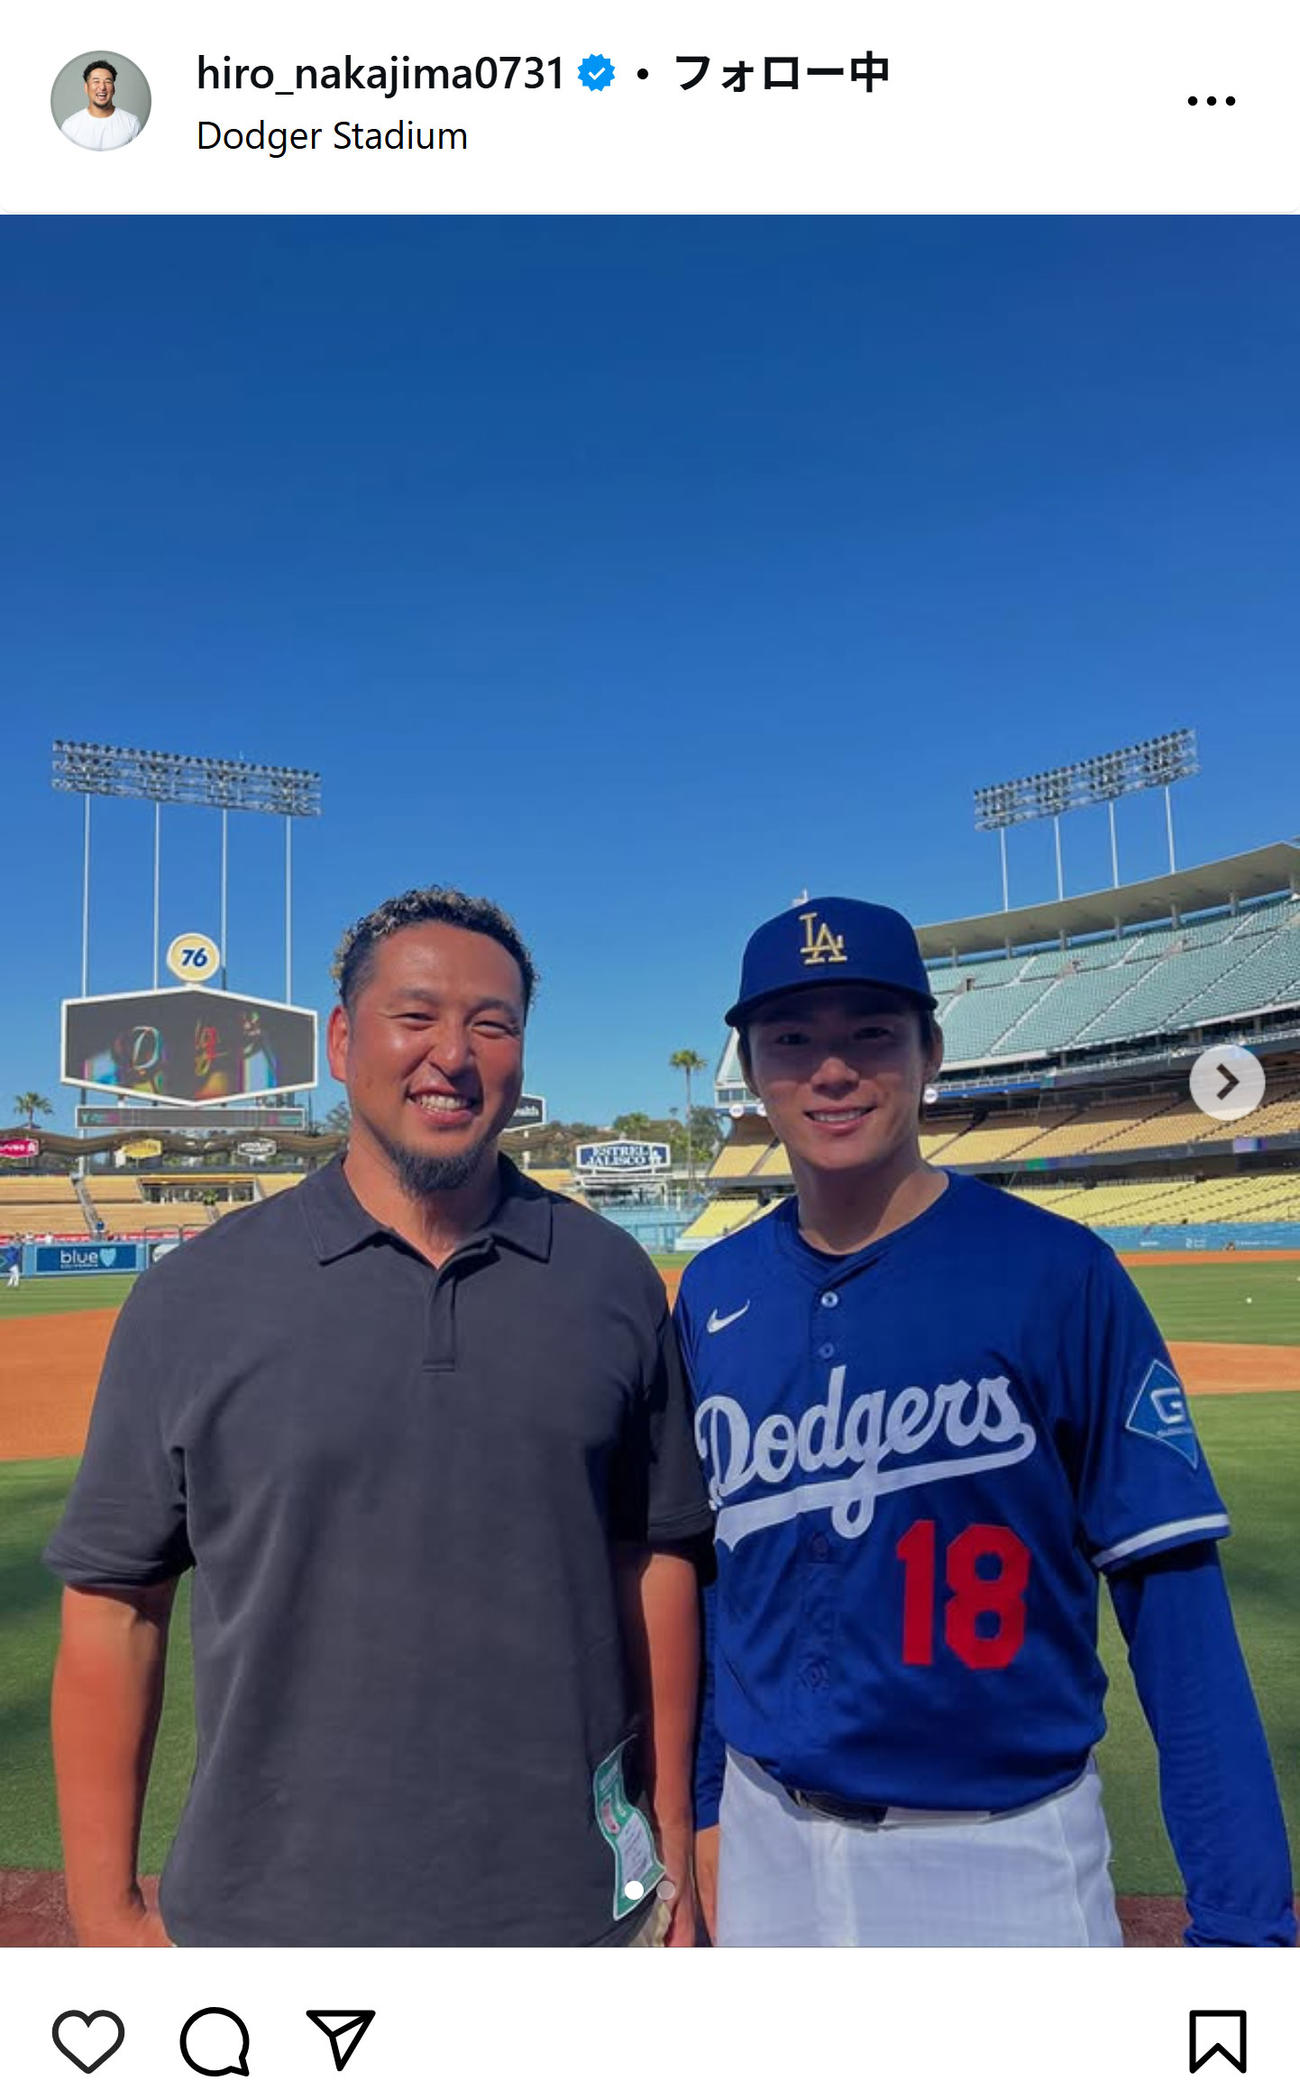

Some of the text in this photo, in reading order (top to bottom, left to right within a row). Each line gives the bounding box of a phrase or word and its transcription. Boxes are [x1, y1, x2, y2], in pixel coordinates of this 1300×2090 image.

[181, 947, 208, 967] 76
[799, 912, 848, 965] LA
[60, 1250, 98, 1264] blue
[695, 1365, 1036, 1541] Dodgers
[897, 1521, 1030, 1670] 18
